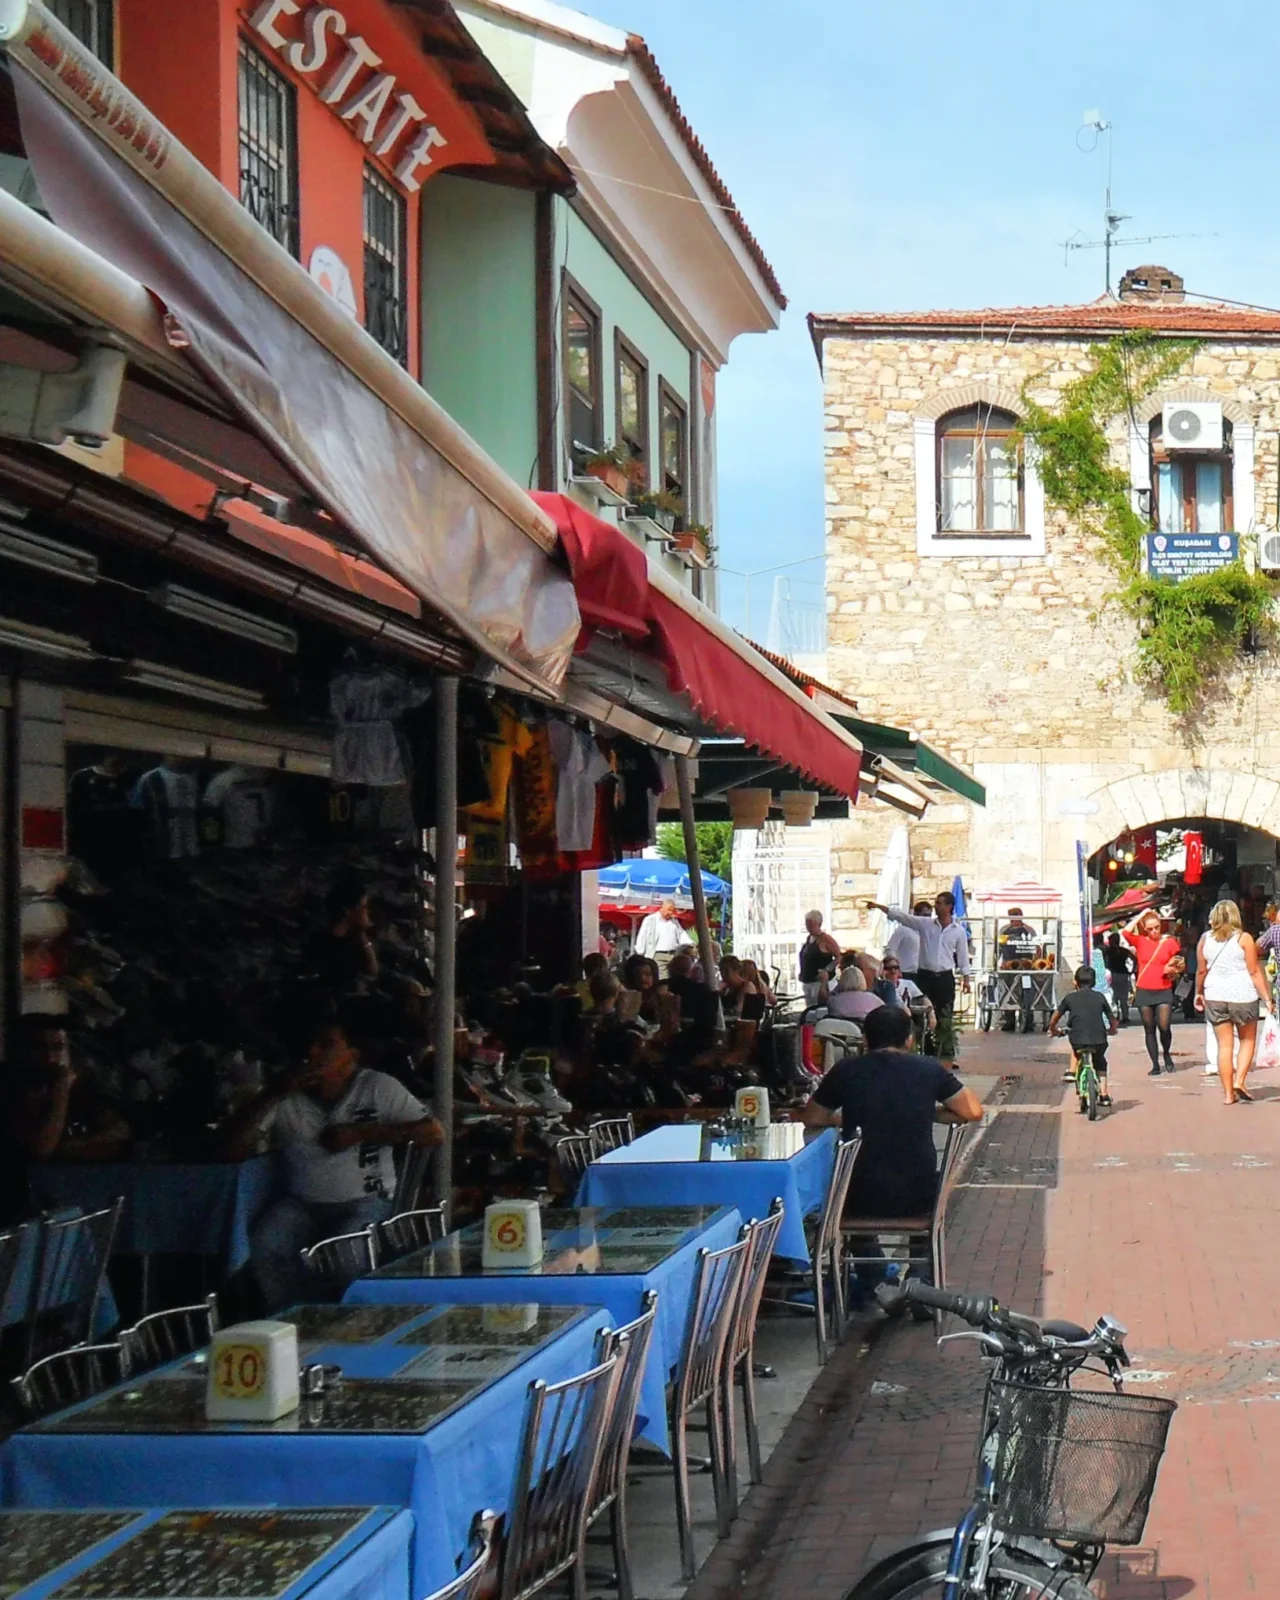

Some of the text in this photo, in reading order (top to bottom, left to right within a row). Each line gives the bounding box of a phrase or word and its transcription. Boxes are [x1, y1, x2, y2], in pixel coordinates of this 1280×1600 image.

[743, 1096, 757, 1113] 5
[497, 1219, 518, 1245] 6
[222, 1352, 258, 1388] 10
